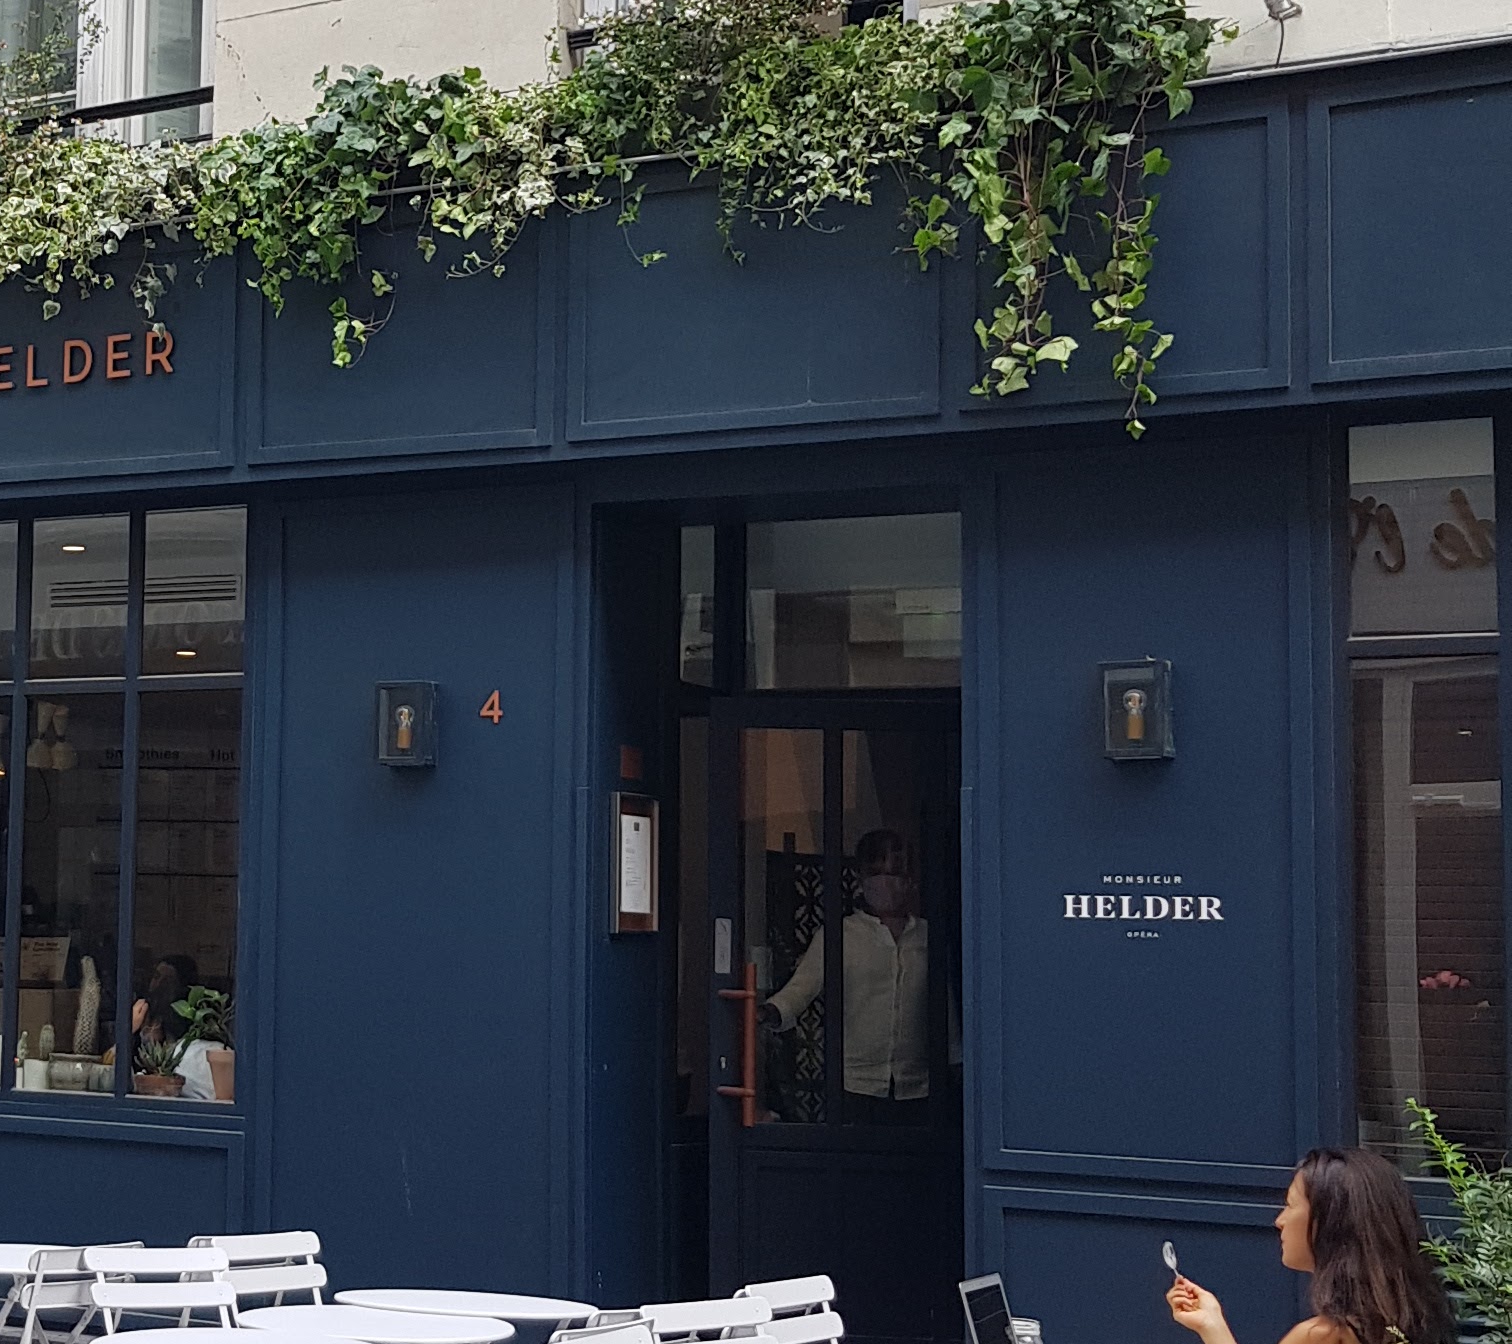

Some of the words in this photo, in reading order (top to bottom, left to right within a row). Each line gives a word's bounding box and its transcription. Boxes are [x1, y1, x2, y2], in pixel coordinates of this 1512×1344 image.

[479, 689, 504, 724] 4
[1103, 874, 1183, 884] MONSIEUR
[1063, 894, 1225, 921] HELDER
